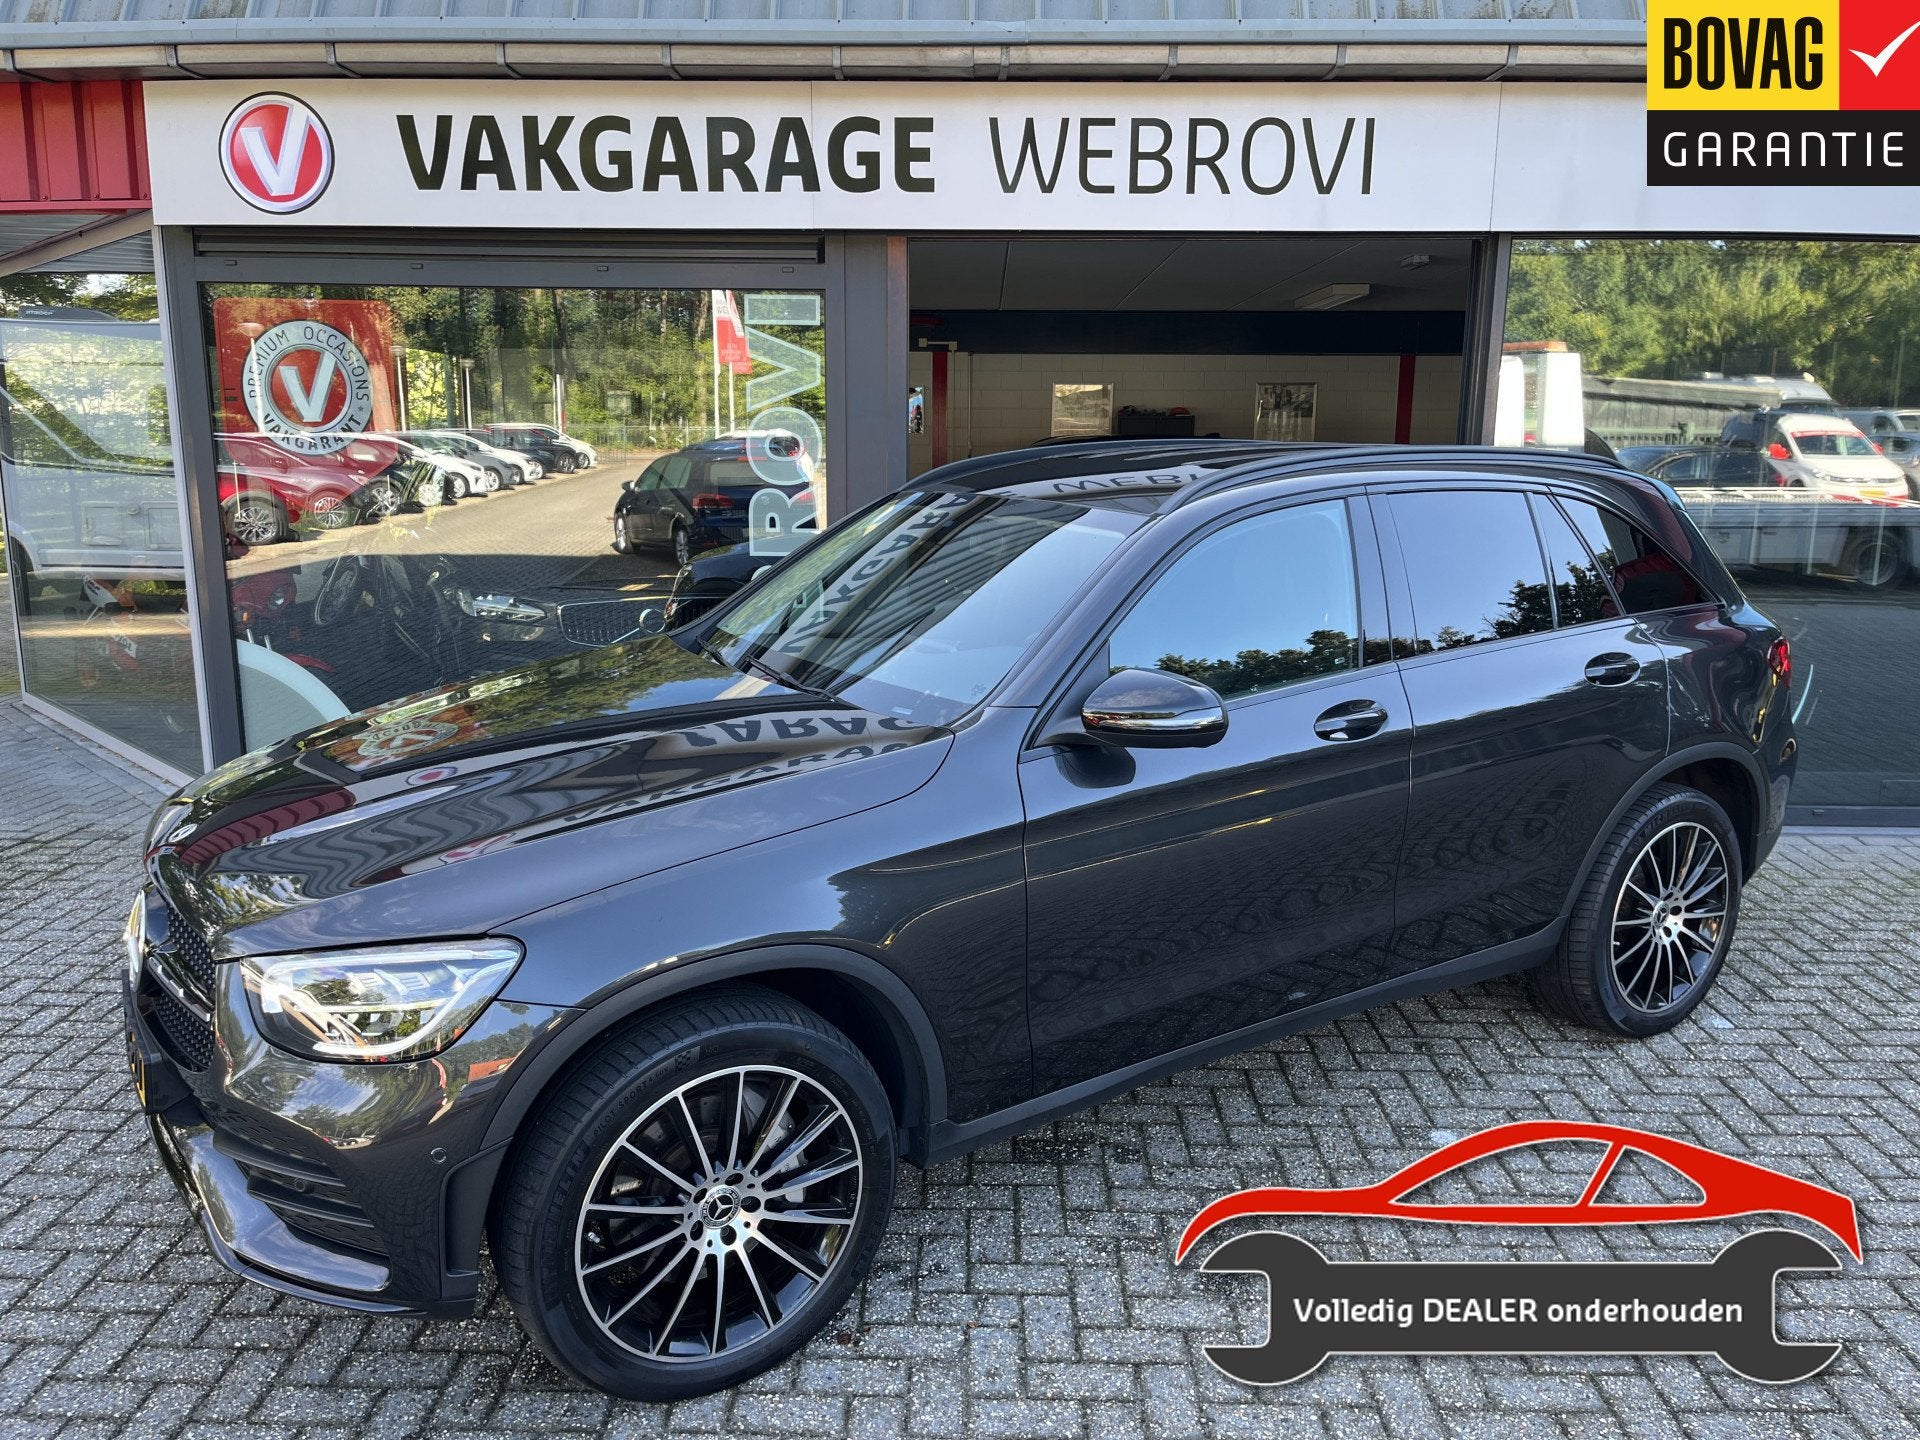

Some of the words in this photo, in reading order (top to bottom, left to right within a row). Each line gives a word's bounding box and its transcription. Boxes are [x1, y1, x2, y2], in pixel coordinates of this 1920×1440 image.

[396, 114, 935, 193] VAKGARAGE
[988, 117, 1376, 196] WEBROVI
[247, 329, 290, 399] PREMIUM
[303, 326, 370, 402] OCCASIONS
[263, 412, 362, 451] VAKGARANT
[592, 1109, 616, 1137] PILOT
[618, 1080, 650, 1109] SPORT
